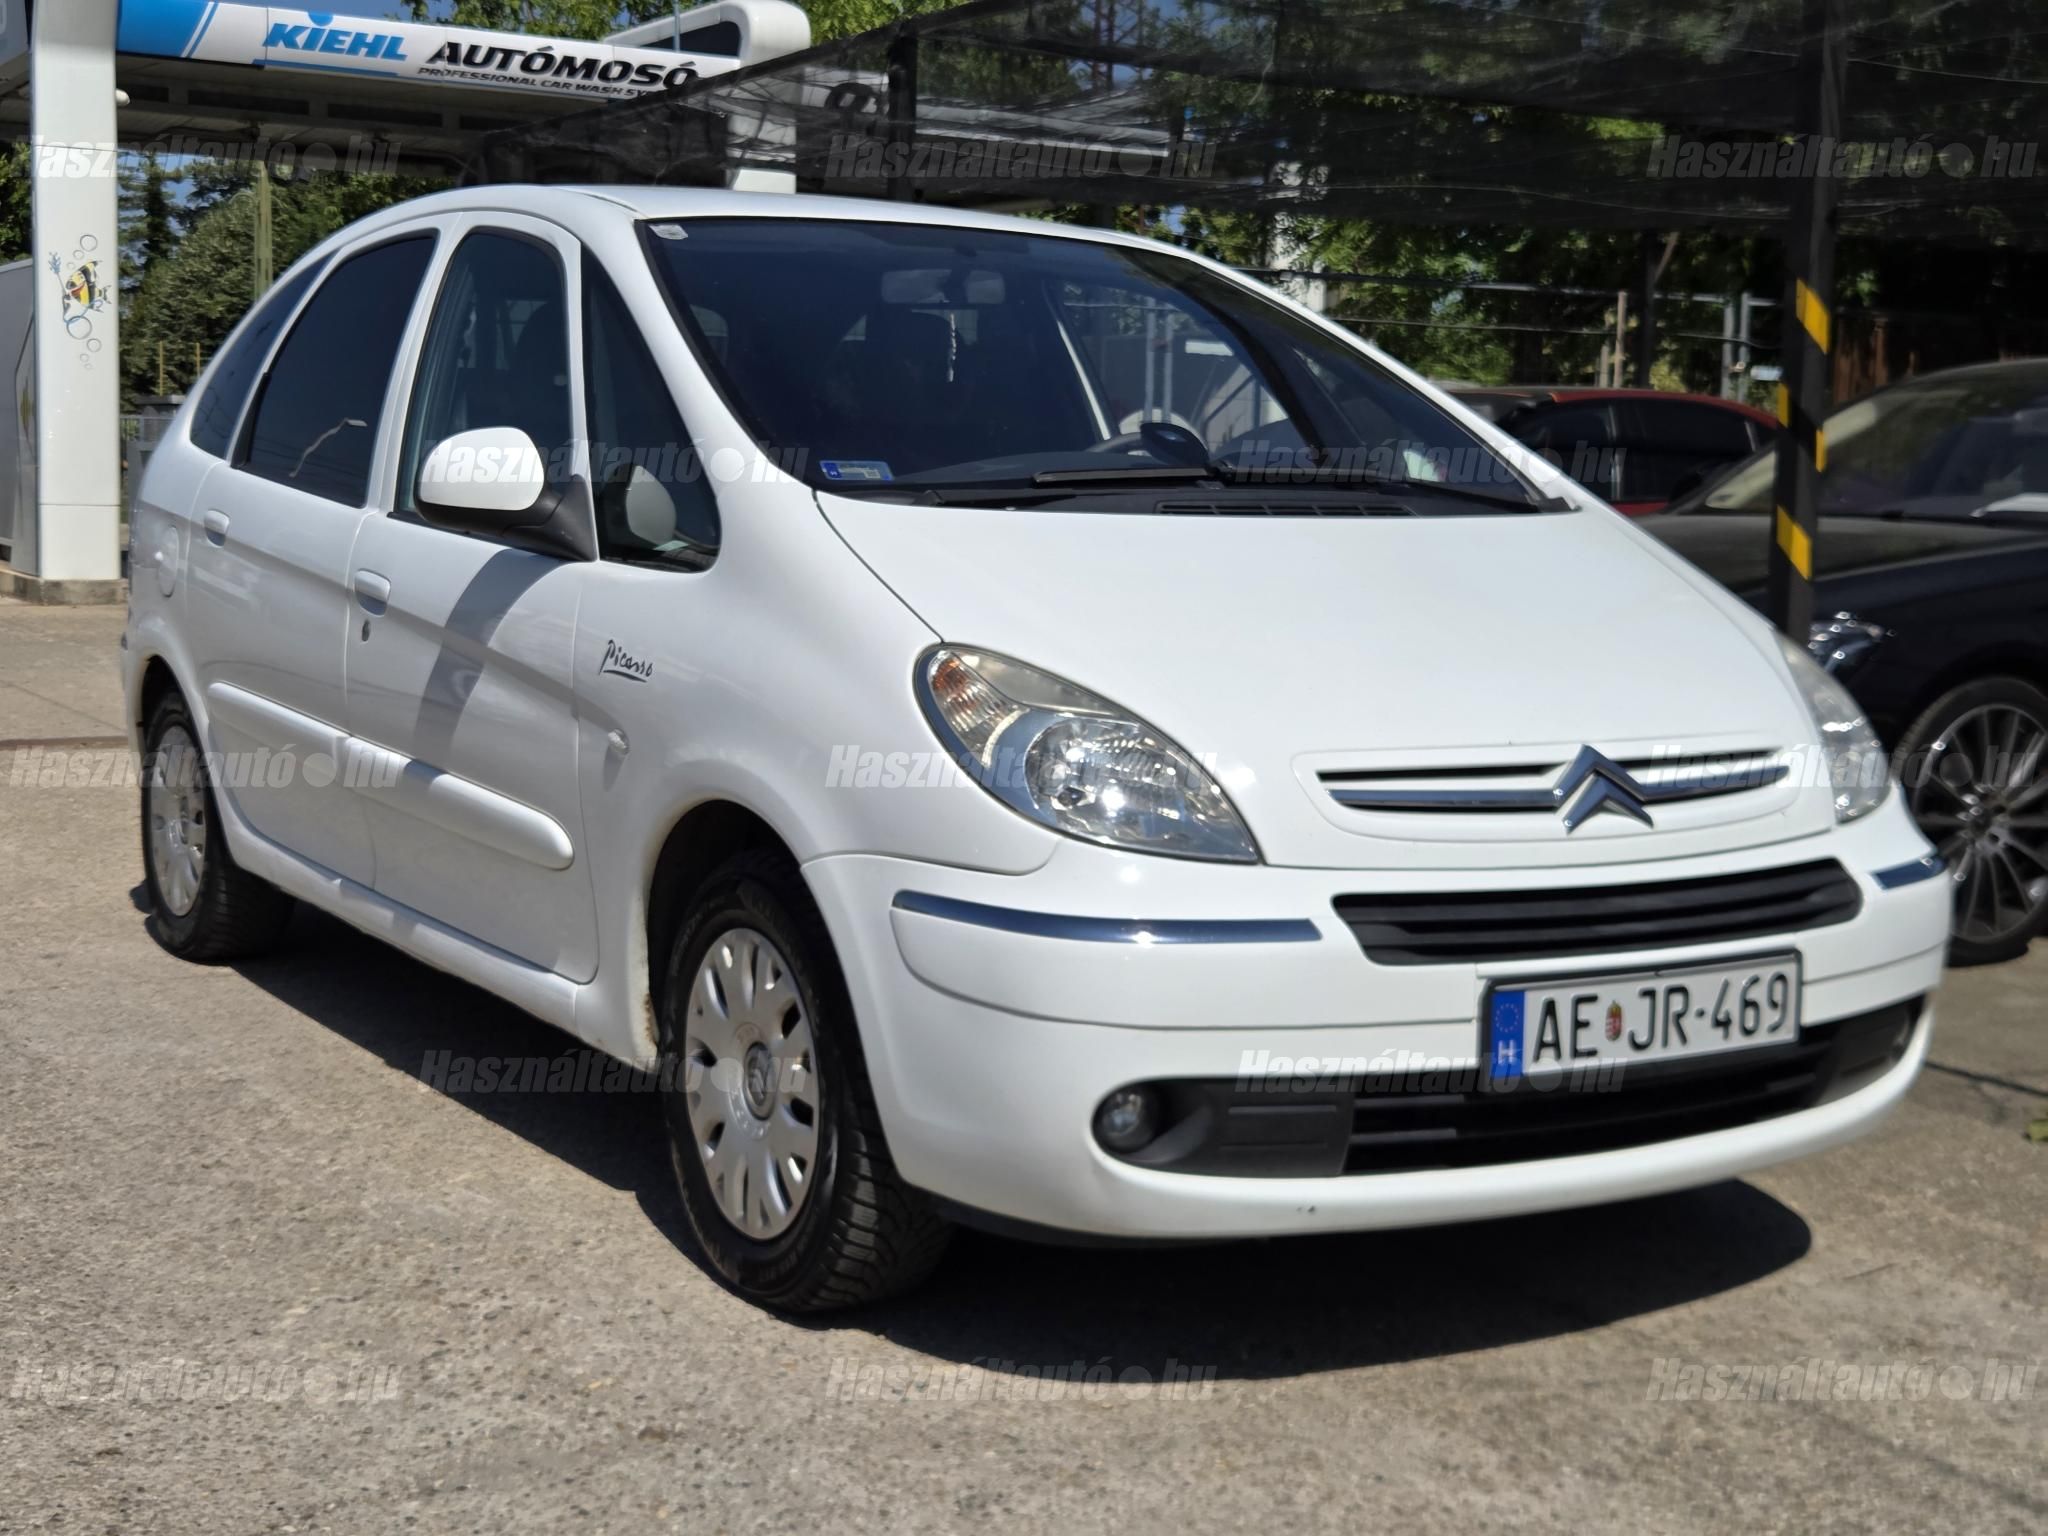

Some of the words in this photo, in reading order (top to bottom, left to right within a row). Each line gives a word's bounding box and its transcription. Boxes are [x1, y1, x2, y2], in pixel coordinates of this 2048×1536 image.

[417, 67, 537, 87] PROFESSIONAL
[540, 79, 574, 90] CAR
[574, 83, 624, 96] WASH
[425, 42, 700, 89] AUTÓMOSÓ
[599, 640, 653, 679] Picasso
[1532, 996, 1598, 1062] AE
[1628, 971, 1788, 1051] JR-469
